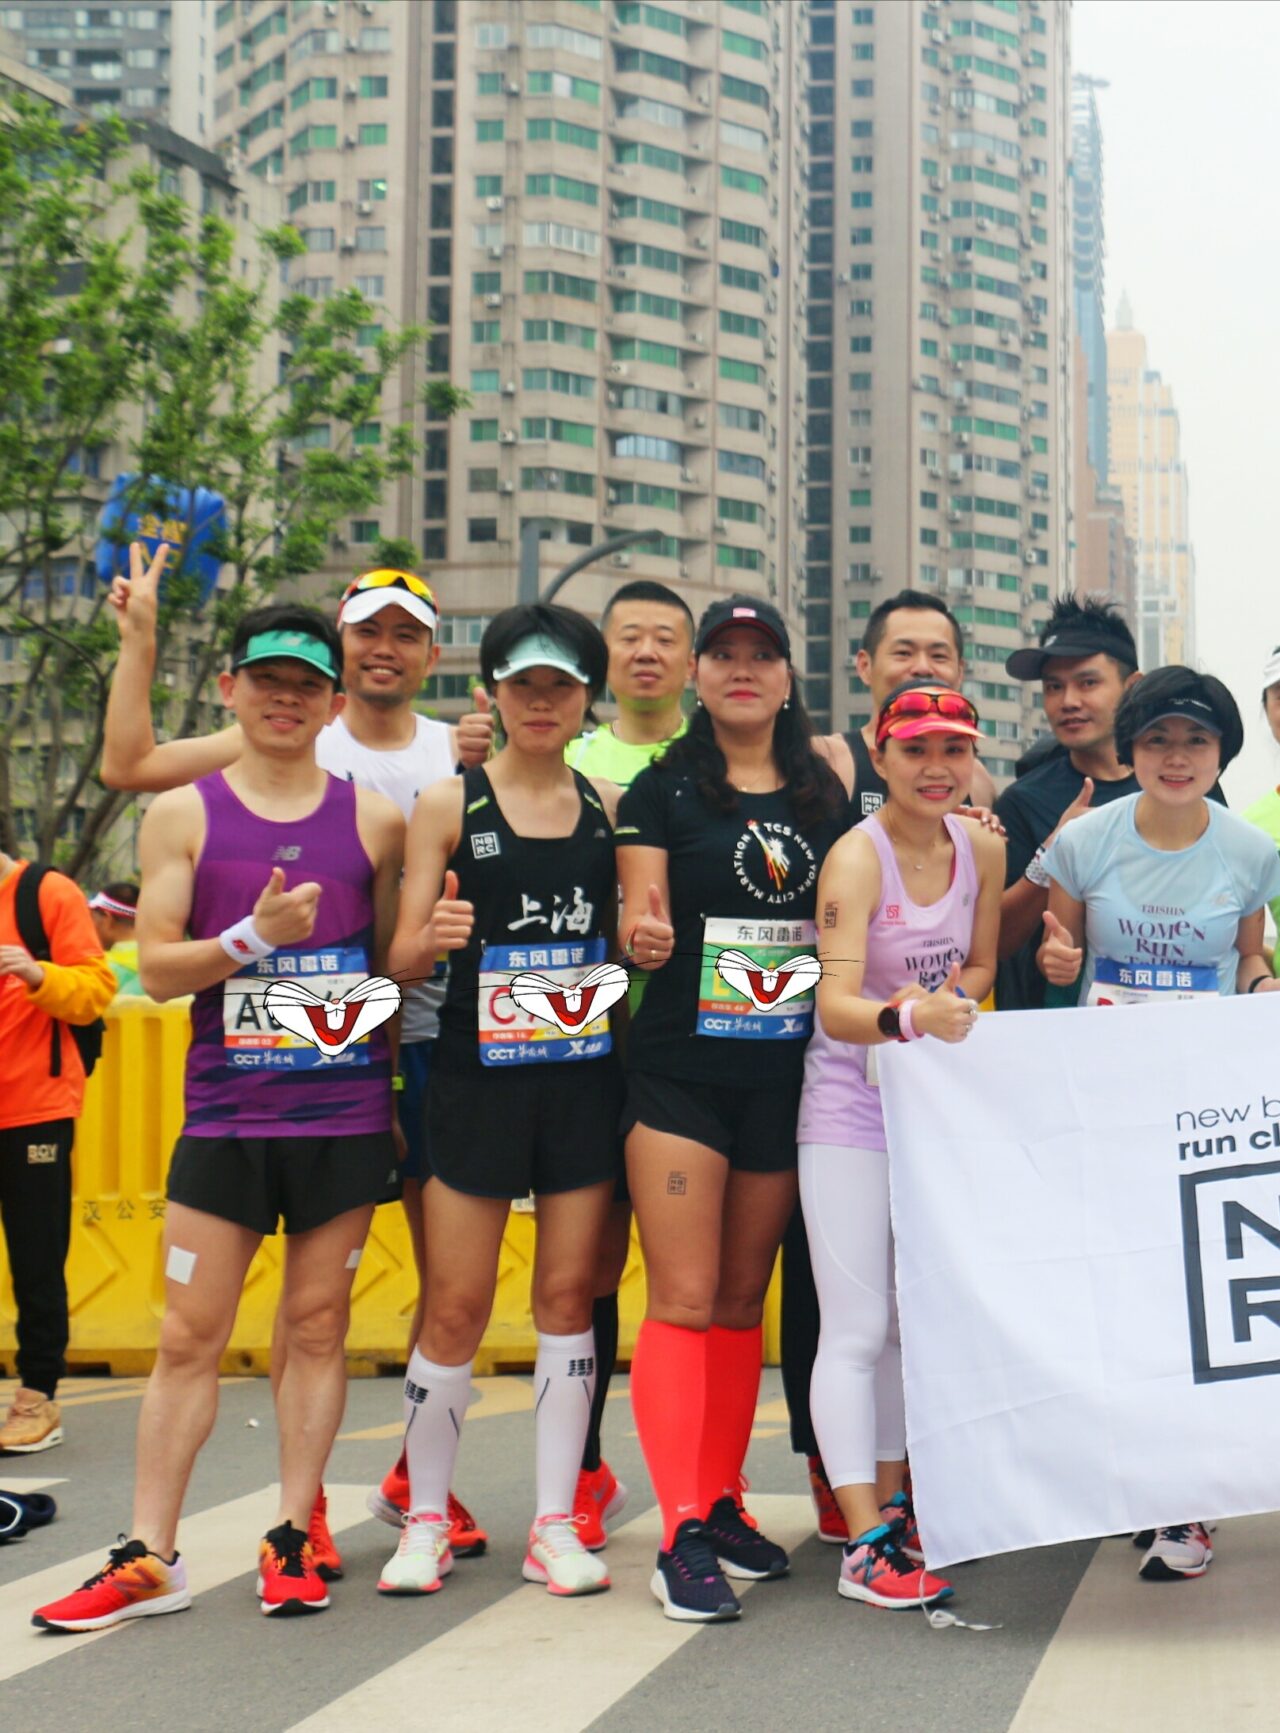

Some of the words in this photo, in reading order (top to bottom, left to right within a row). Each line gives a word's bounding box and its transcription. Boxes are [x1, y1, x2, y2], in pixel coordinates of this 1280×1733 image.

[763, 822, 792, 837] TCS
[475, 836, 494, 845] NB
[476, 844, 495, 855] RC
[793, 834, 815, 861] NEW
[733, 833, 765, 900] MARATHON
[797, 864, 817, 894] YORK
[767, 891, 795, 904] CITY
[507, 886, 594, 935] 上海
[737, 926, 802, 942] 东风雷诺
[257, 954, 339, 974] 东风雷诺
[508, 947, 585, 968] 东风雷诺
[1119, 968, 1193, 988] 东风雷诺
[704, 1018, 732, 1030] OCT
[233, 1053, 260, 1066] OCT
[487, 1049, 516, 1061] OCT
[1175, 1100, 1252, 1131] new
[27, 1144, 58, 1159] BOY
[1178, 1135, 1238, 1161] run
